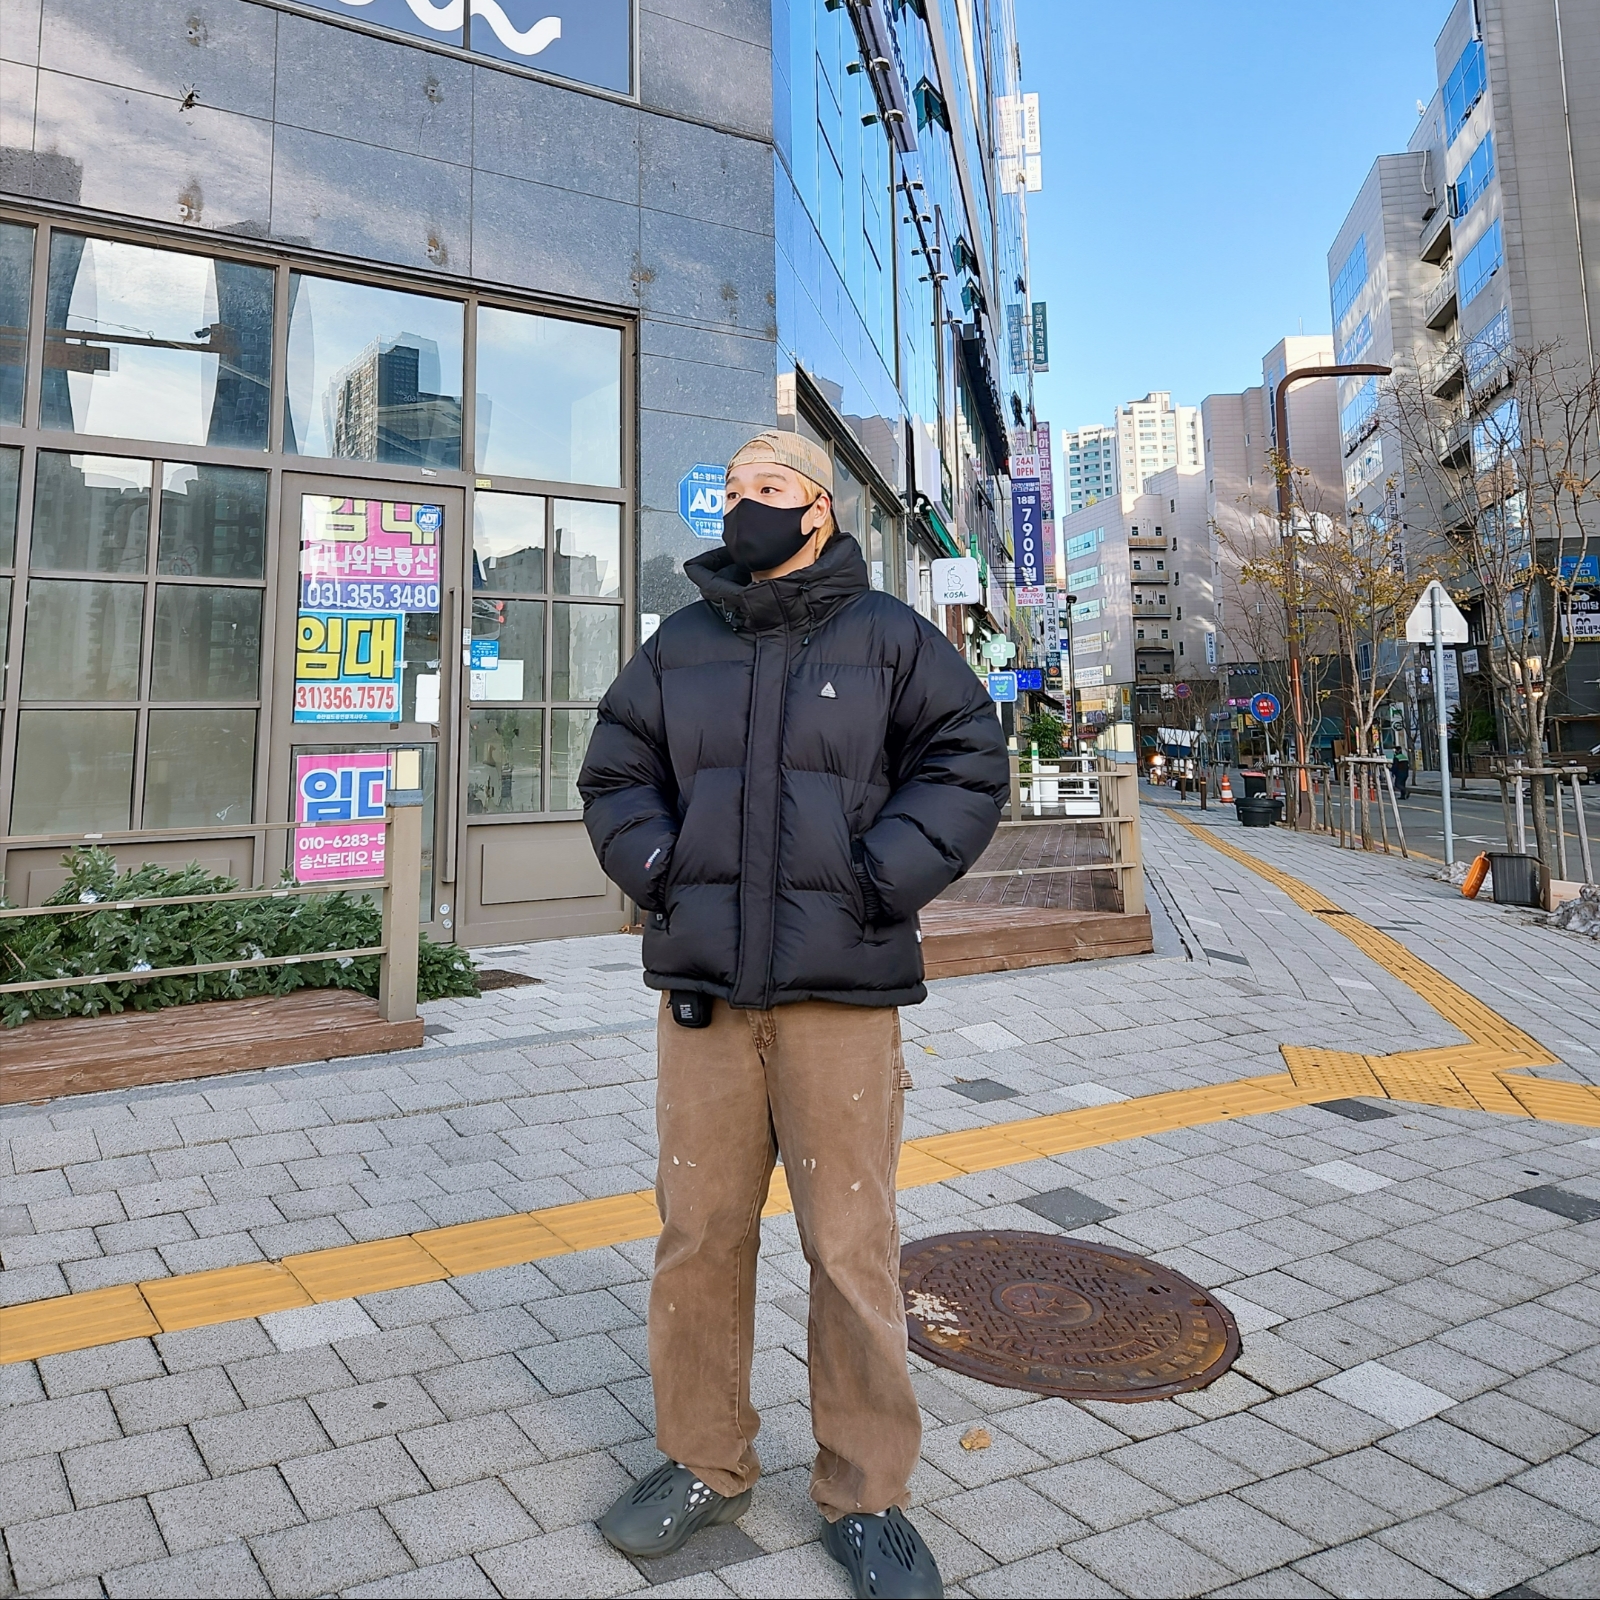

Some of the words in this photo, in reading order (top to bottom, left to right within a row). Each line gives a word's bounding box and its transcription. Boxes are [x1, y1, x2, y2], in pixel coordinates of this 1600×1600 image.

[1016, 457, 1034, 466] 24시
[1038, 438, 1050, 469] 아로마
[1016, 467, 1034, 476] OPEN
[1016, 496, 1036, 505] 18홀
[419, 514, 438, 525] ADT
[307, 583, 438, 608] 031.355.3480
[943, 591, 969, 599] KOSAL
[1046, 593, 1058, 650] 시그니처독서실
[296, 617, 396, 679] 임대
[990, 643, 1007, 660] 약
[295, 686, 395, 710] 31)356.7575
[299, 851, 369, 870] 송산로데오
